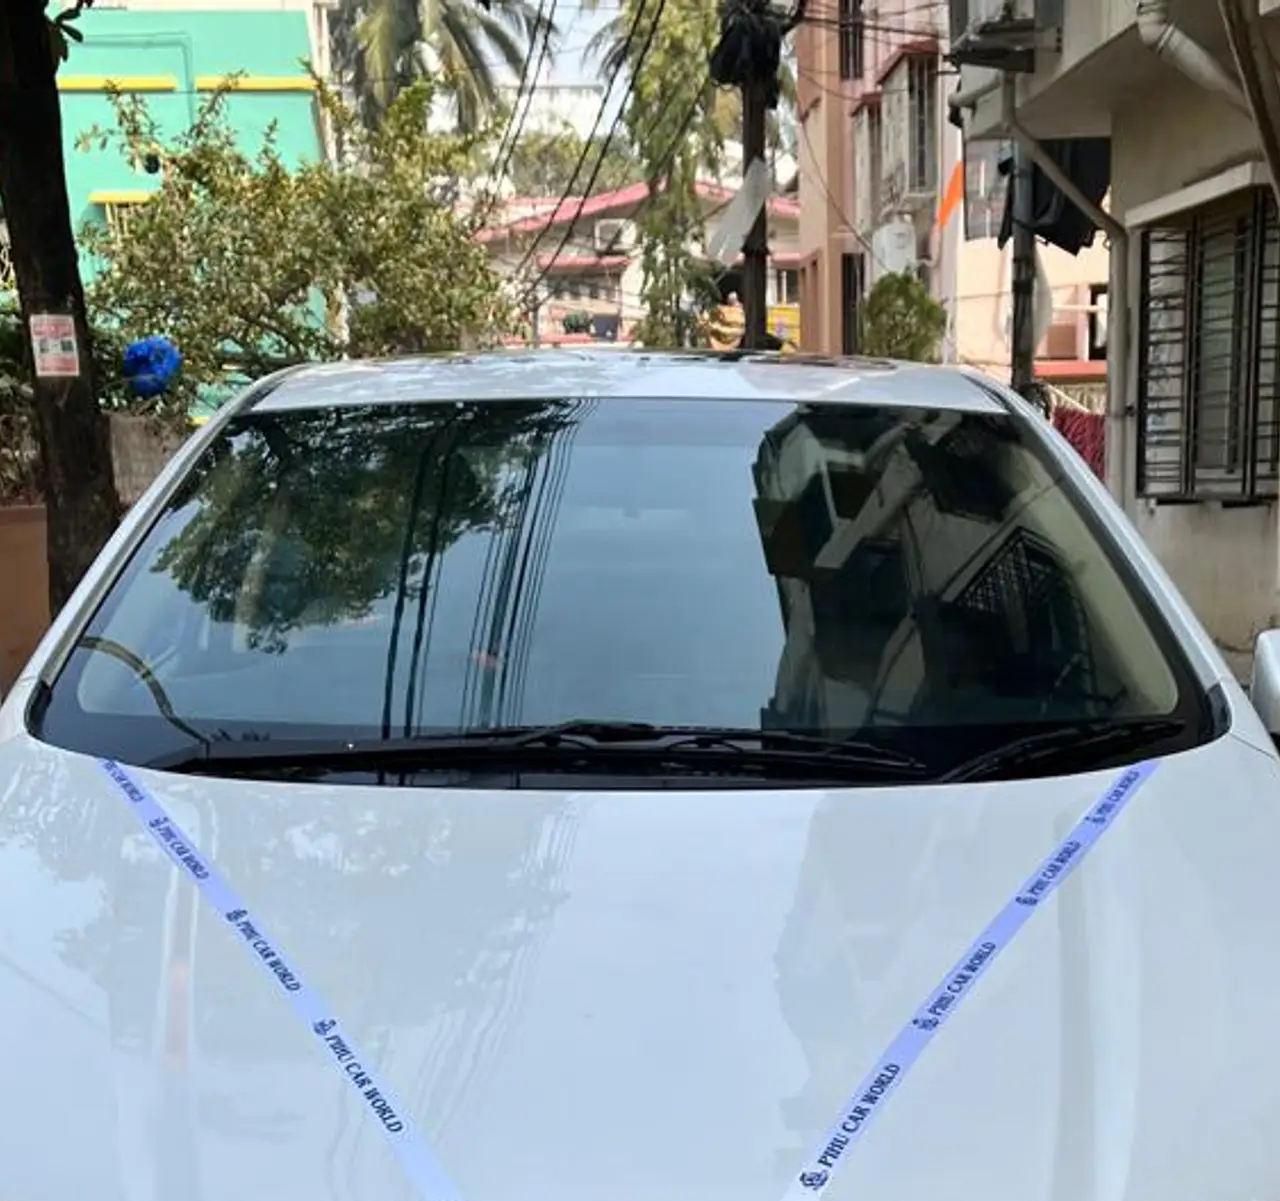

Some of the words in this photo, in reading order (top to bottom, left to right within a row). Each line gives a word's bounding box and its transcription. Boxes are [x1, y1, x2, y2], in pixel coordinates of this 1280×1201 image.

[253, 940, 276, 961] CAR
[266, 958, 301, 991] WORLD
[947, 973, 972, 993] CAR
[963, 942, 996, 972] WORLD
[345, 1062, 373, 1089] CAR
[363, 1087, 404, 1133] WORLD
[842, 1105, 871, 1133] CAR
[861, 1063, 900, 1105] WORLD
